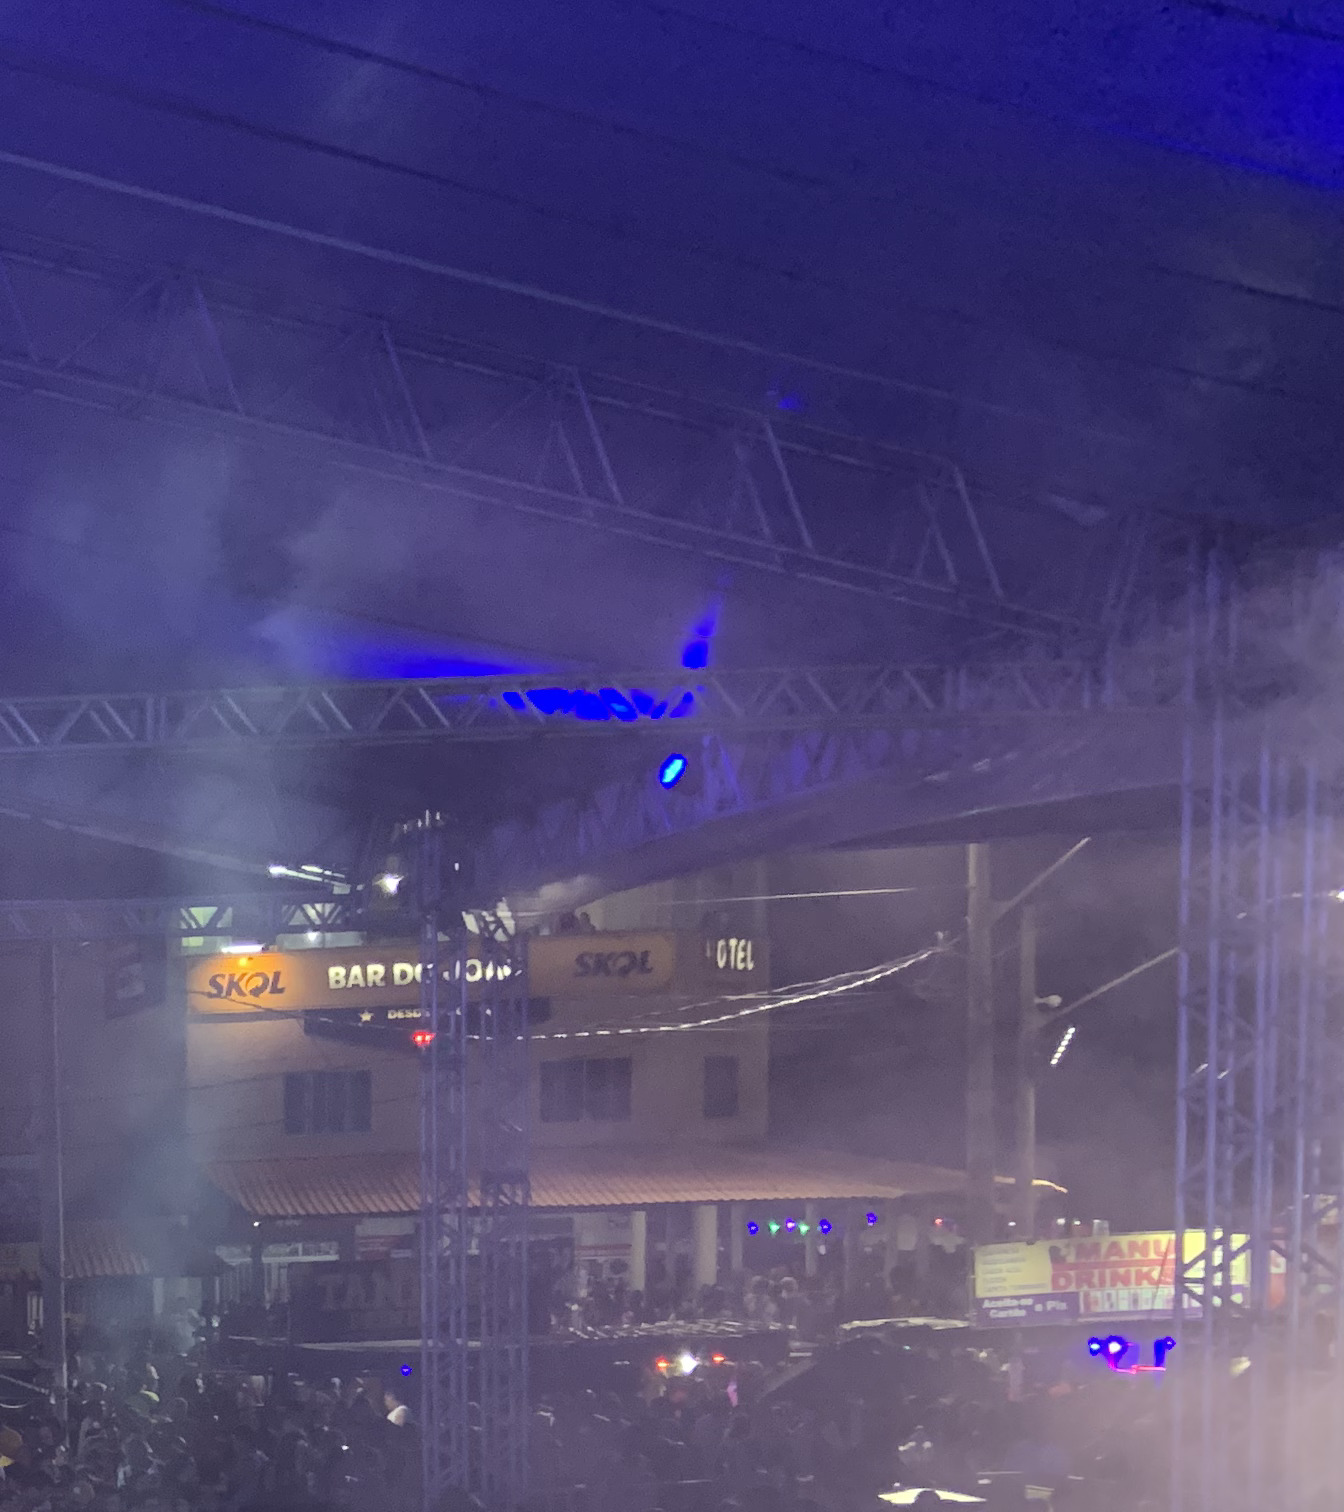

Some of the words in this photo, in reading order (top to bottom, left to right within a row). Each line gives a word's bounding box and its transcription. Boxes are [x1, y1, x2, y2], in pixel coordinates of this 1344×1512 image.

[574, 949, 654, 979] SKOL
[706, 937, 754, 971] OTEL
[207, 969, 287, 999] SKOL
[328, 962, 386, 990] BAR
